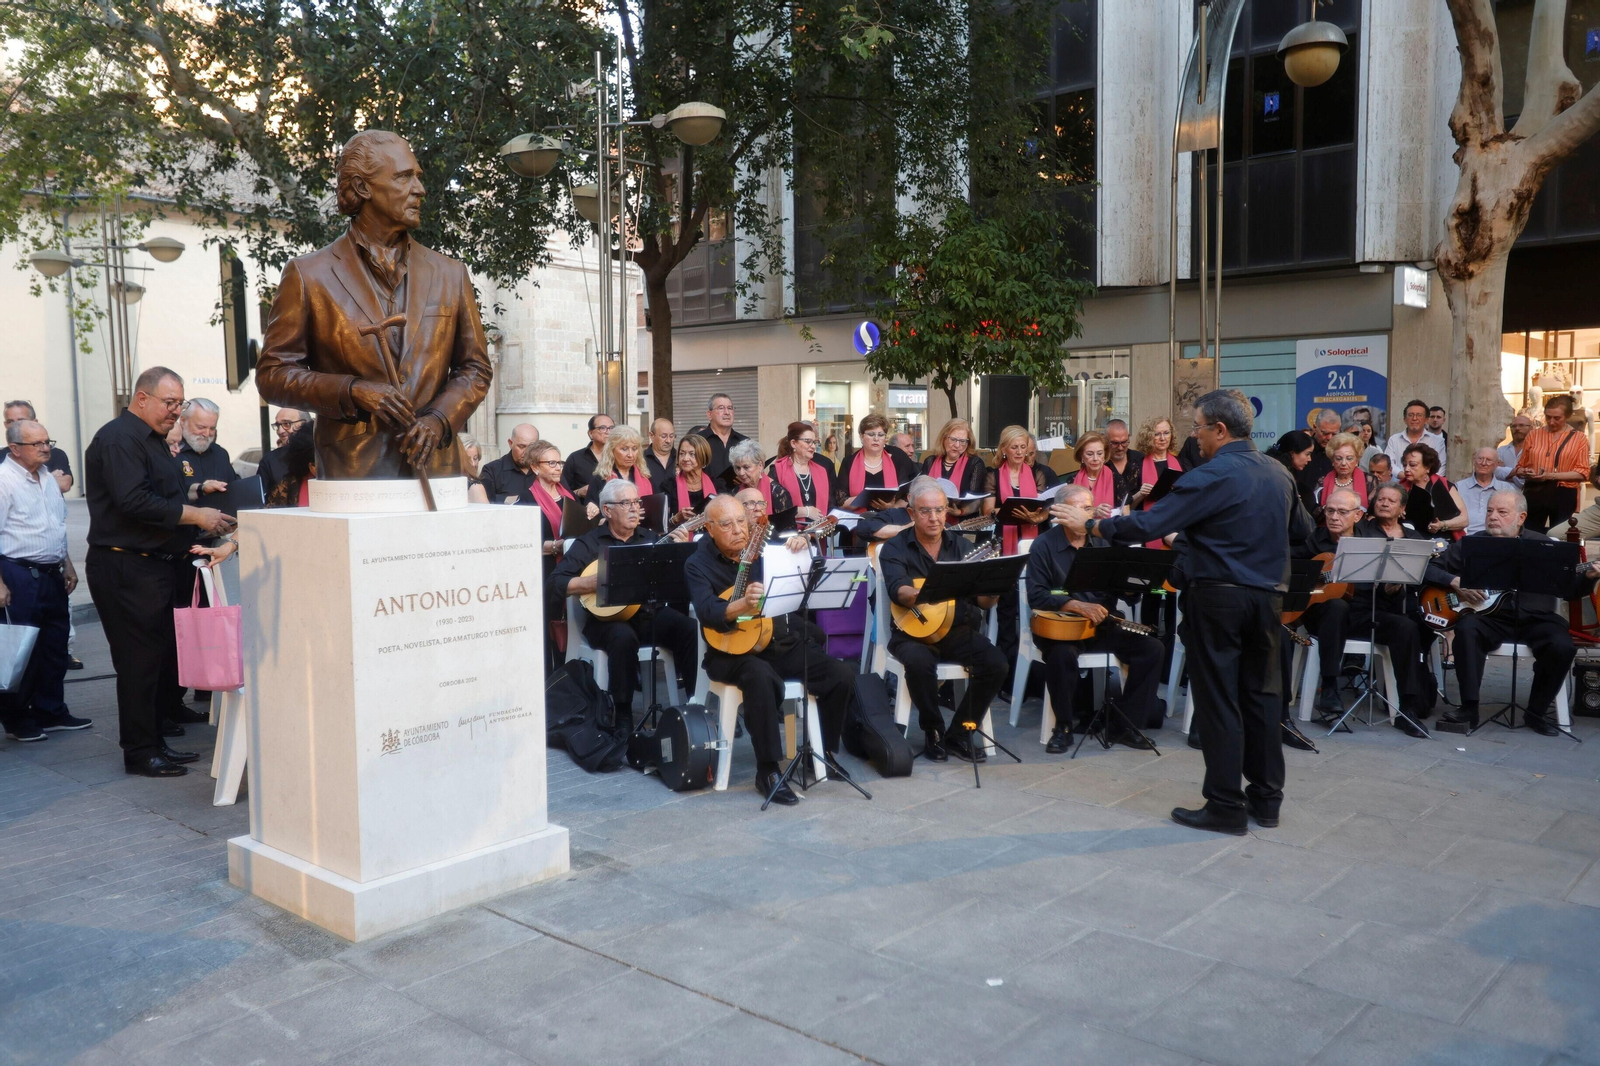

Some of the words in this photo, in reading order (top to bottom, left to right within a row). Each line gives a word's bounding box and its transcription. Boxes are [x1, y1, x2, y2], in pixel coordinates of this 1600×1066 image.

[1327, 347, 1369, 357] Soloptical
[1327, 370, 1354, 390] 2x1
[370, 553, 416, 564] AYUNTAMIENTO
[495, 543, 519, 551] ANTONIO
[373, 587, 472, 618] ANTONIO
[476, 580, 529, 604] GALA
[435, 616, 453, 627] (1930
[457, 614, 475, 624] 2023)
[378, 644, 403, 654] POETA,
[403, 638, 443, 650] NOVELISTA,
[443, 631, 489, 645] DRAMATURGO
[494, 625, 528, 637] ENSAYISTA
[465, 676, 478, 684] 2024
[488, 706, 523, 717] FUNDACIÓN
[488, 713, 516, 724] ANTONIO
[516, 711, 533, 719] GALA
[403, 720, 449, 737] AYUNTAMIENTO
[403, 738, 412, 748] DE
[411, 731, 441, 746] CÓRDOBA
